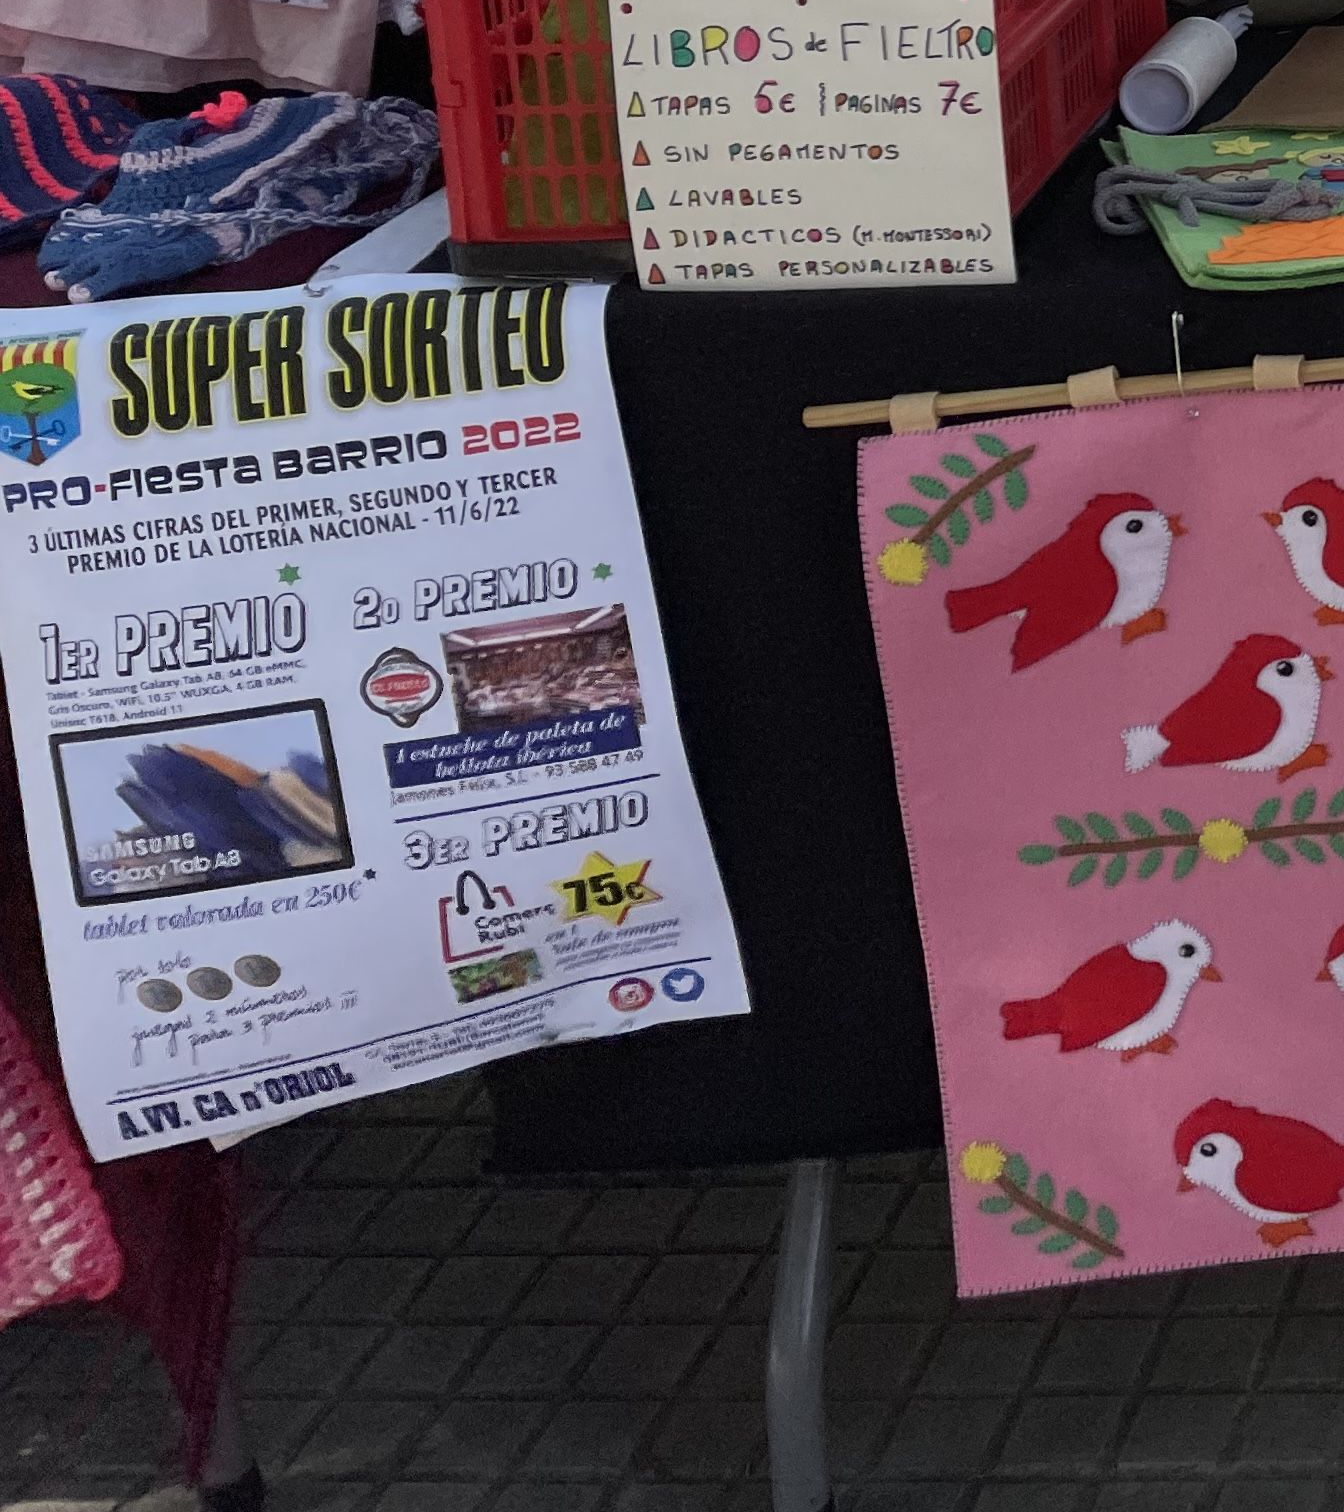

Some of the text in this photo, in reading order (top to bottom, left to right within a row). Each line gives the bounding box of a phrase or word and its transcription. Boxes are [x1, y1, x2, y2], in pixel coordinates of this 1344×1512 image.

[622, 19, 994, 68] LIBROS de FIELTRO
[651, 95, 731, 116] TAPAS
[835, 91, 922, 114] PAGINAS
[937, 80, 983, 116] 7€
[663, 141, 900, 163] SIN PEGAMENTOS
[668, 189, 803, 208] LAVABLES
[673, 226, 842, 248] DIDACTICOS
[675, 258, 995, 281] TAPAS PERSONALIZABLES
[110, 305, 308, 437] SUPER
[462, 412, 581, 456] 2022
[28, 466, 558, 554] 3 ÚLTIMAS CIFRAS DEL PRIMER, SEGUNDO Y TERCER
[68, 545, 147, 574] PREMIO
[155, 542, 182, 564] DE
[189, 538, 215, 560] LA
[221, 522, 305, 555] LOTERÍA
[311, 511, 417, 544] NACIONAL
[433, 495, 521, 527] 11/6/22
[414, 557, 579, 622] PREMIO
[115, 592, 307, 677] PREMIO
[46, 691, 79, 702] Tablet
[88, 683, 139, 698] Samsung
[140, 678, 181, 692] Galaxy
[182, 674, 203, 685] Tab
[122, 705, 168, 721] Android
[494, 729, 521, 749] de
[599, 711, 626, 731] de
[602, 753, 620, 766] 47
[481, 790, 650, 857] PREMIO
[85, 832, 197, 863] SAMSUNG
[90, 860, 168, 887] Galaxy
[170, 851, 211, 875] Tab
[82, 910, 149, 942] tablet
[270, 892, 300, 914] en
[193, 1090, 239, 1122] CA
